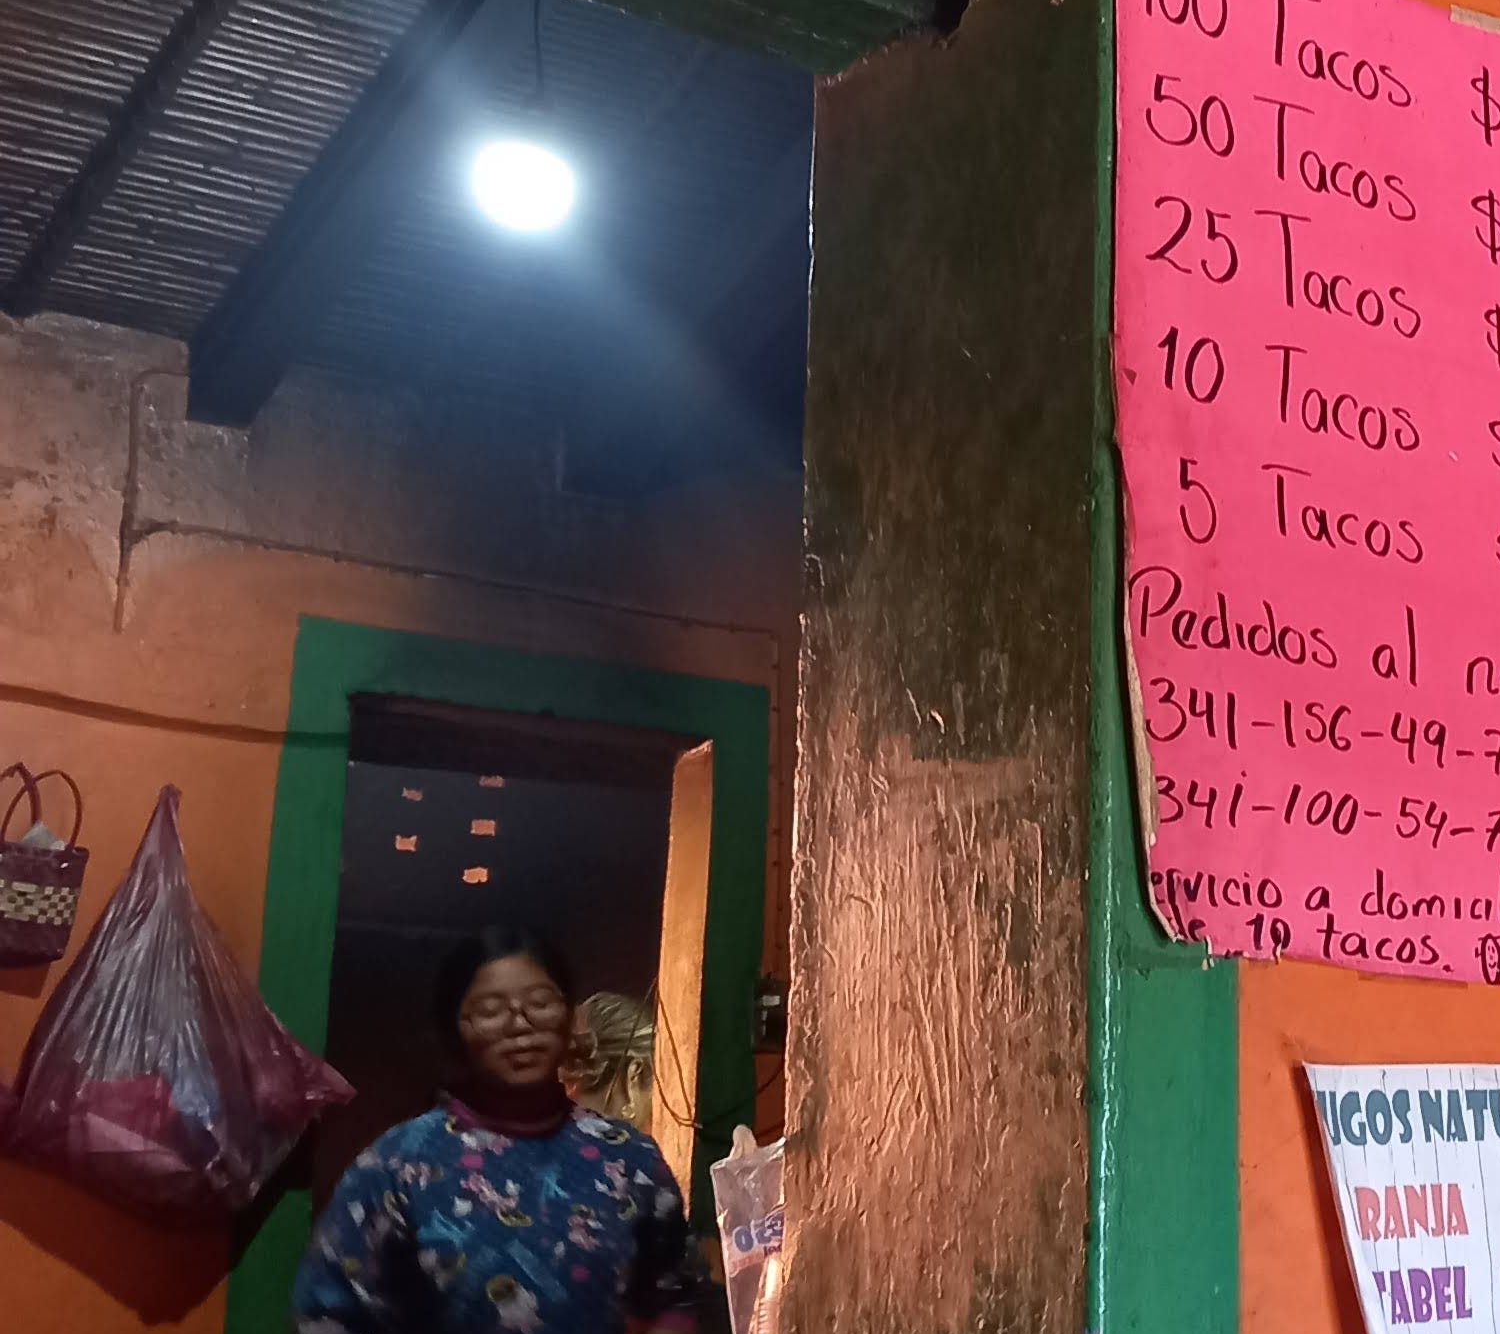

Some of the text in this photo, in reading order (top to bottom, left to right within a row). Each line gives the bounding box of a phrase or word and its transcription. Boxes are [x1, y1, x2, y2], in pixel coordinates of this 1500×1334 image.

[1145, 73, 1235, 157] 50
[1254, 95, 1416, 222] Tacos
[1145, 195, 1239, 284] 25
[1255, 209, 1421, 339] Tacos
[1157, 326, 1225, 404] 10
[1265, 345, 1420, 451] Tacos
[1179, 457, 1217, 544] 5
[1261, 464, 1424, 564] Tacos
[1128, 565, 1338, 669] Pedidos
[1371, 605, 1417, 687] al
[1304, 886, 1331, 912] a
[1354, 1182, 1469, 1241] RANJA
